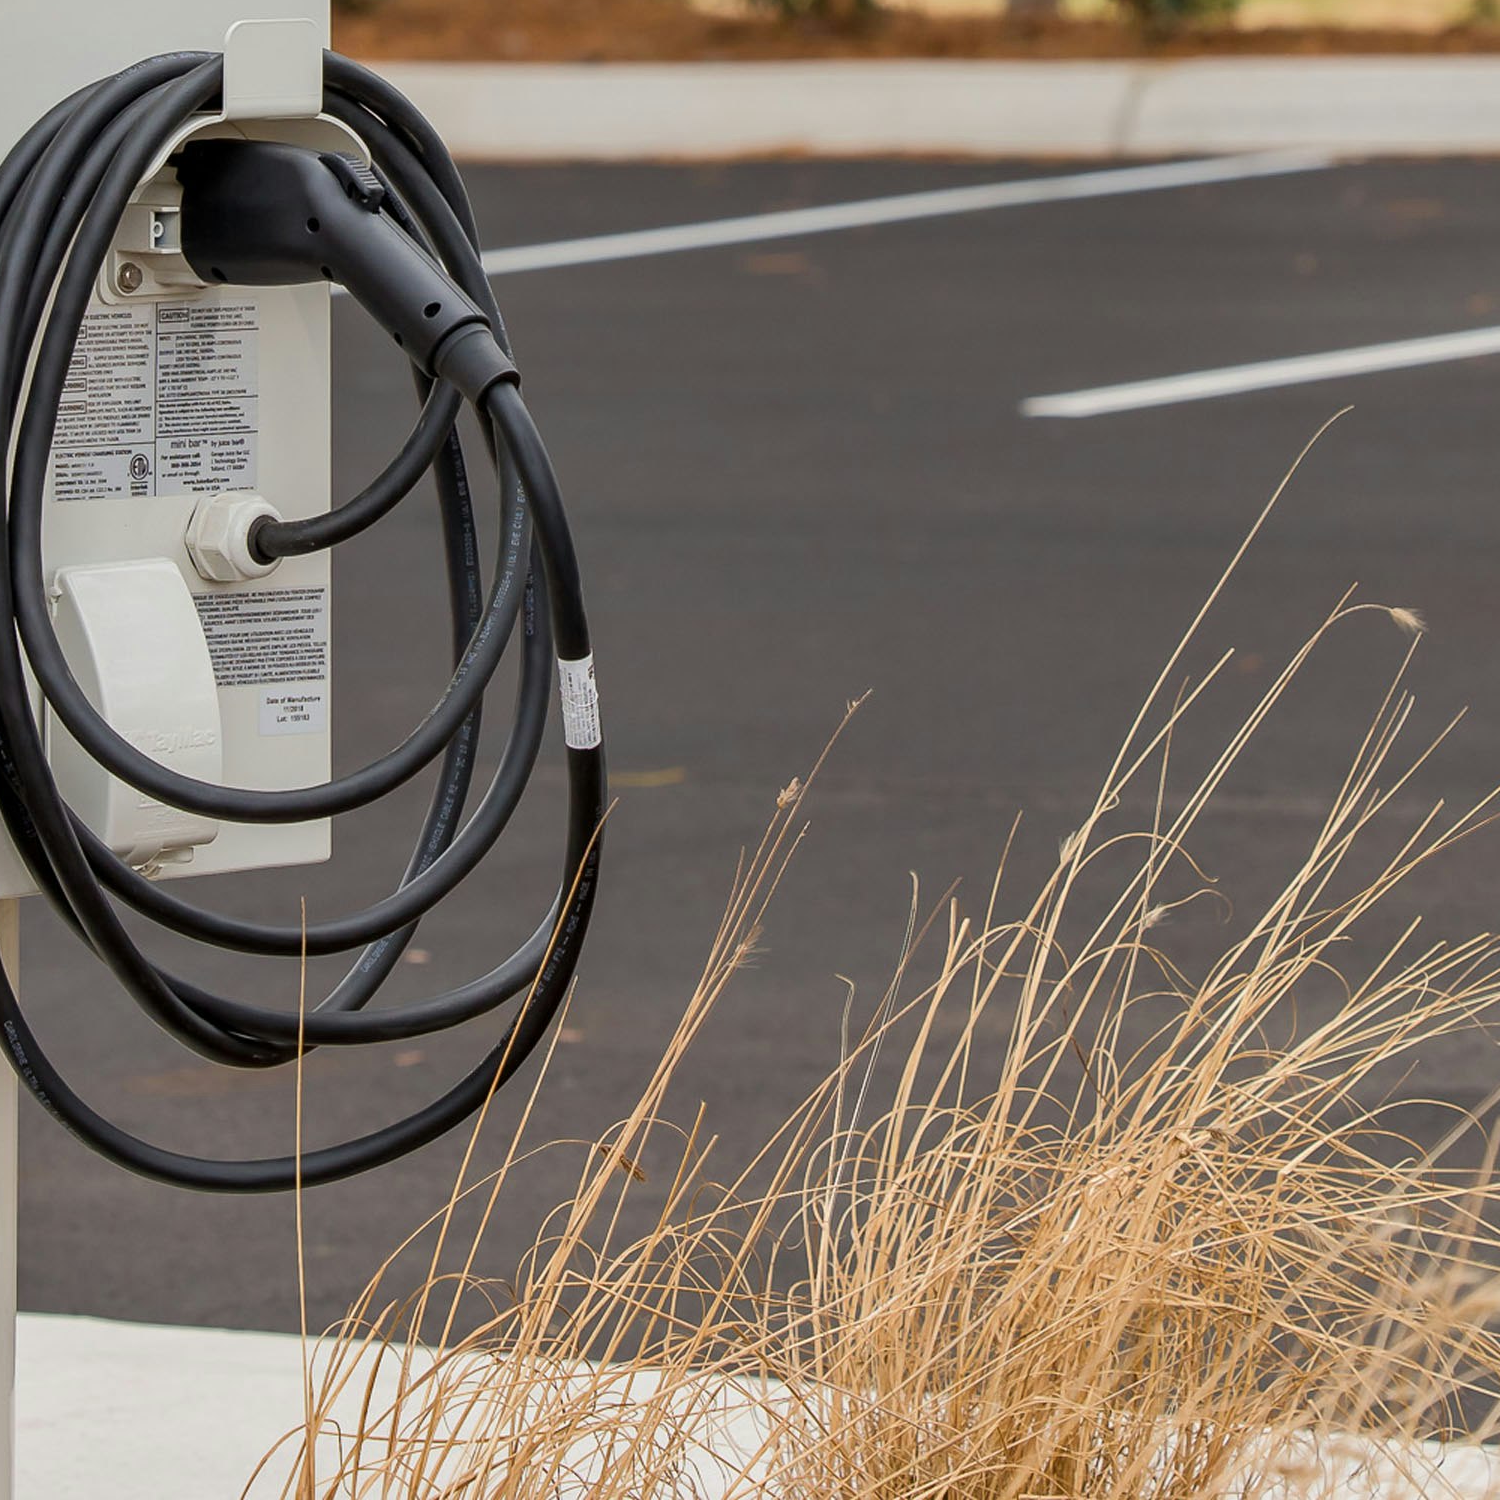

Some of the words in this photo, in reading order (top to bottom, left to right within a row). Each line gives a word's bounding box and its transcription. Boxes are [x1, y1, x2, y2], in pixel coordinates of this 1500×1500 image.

[161, 311, 188, 320] CAUTION
[63, 381, 85, 389] ARNING
[170, 438, 187, 449] mini
[210, 440, 218, 448] by
[266, 697, 279, 705] Date
[286, 695, 321, 703] Manufacture
